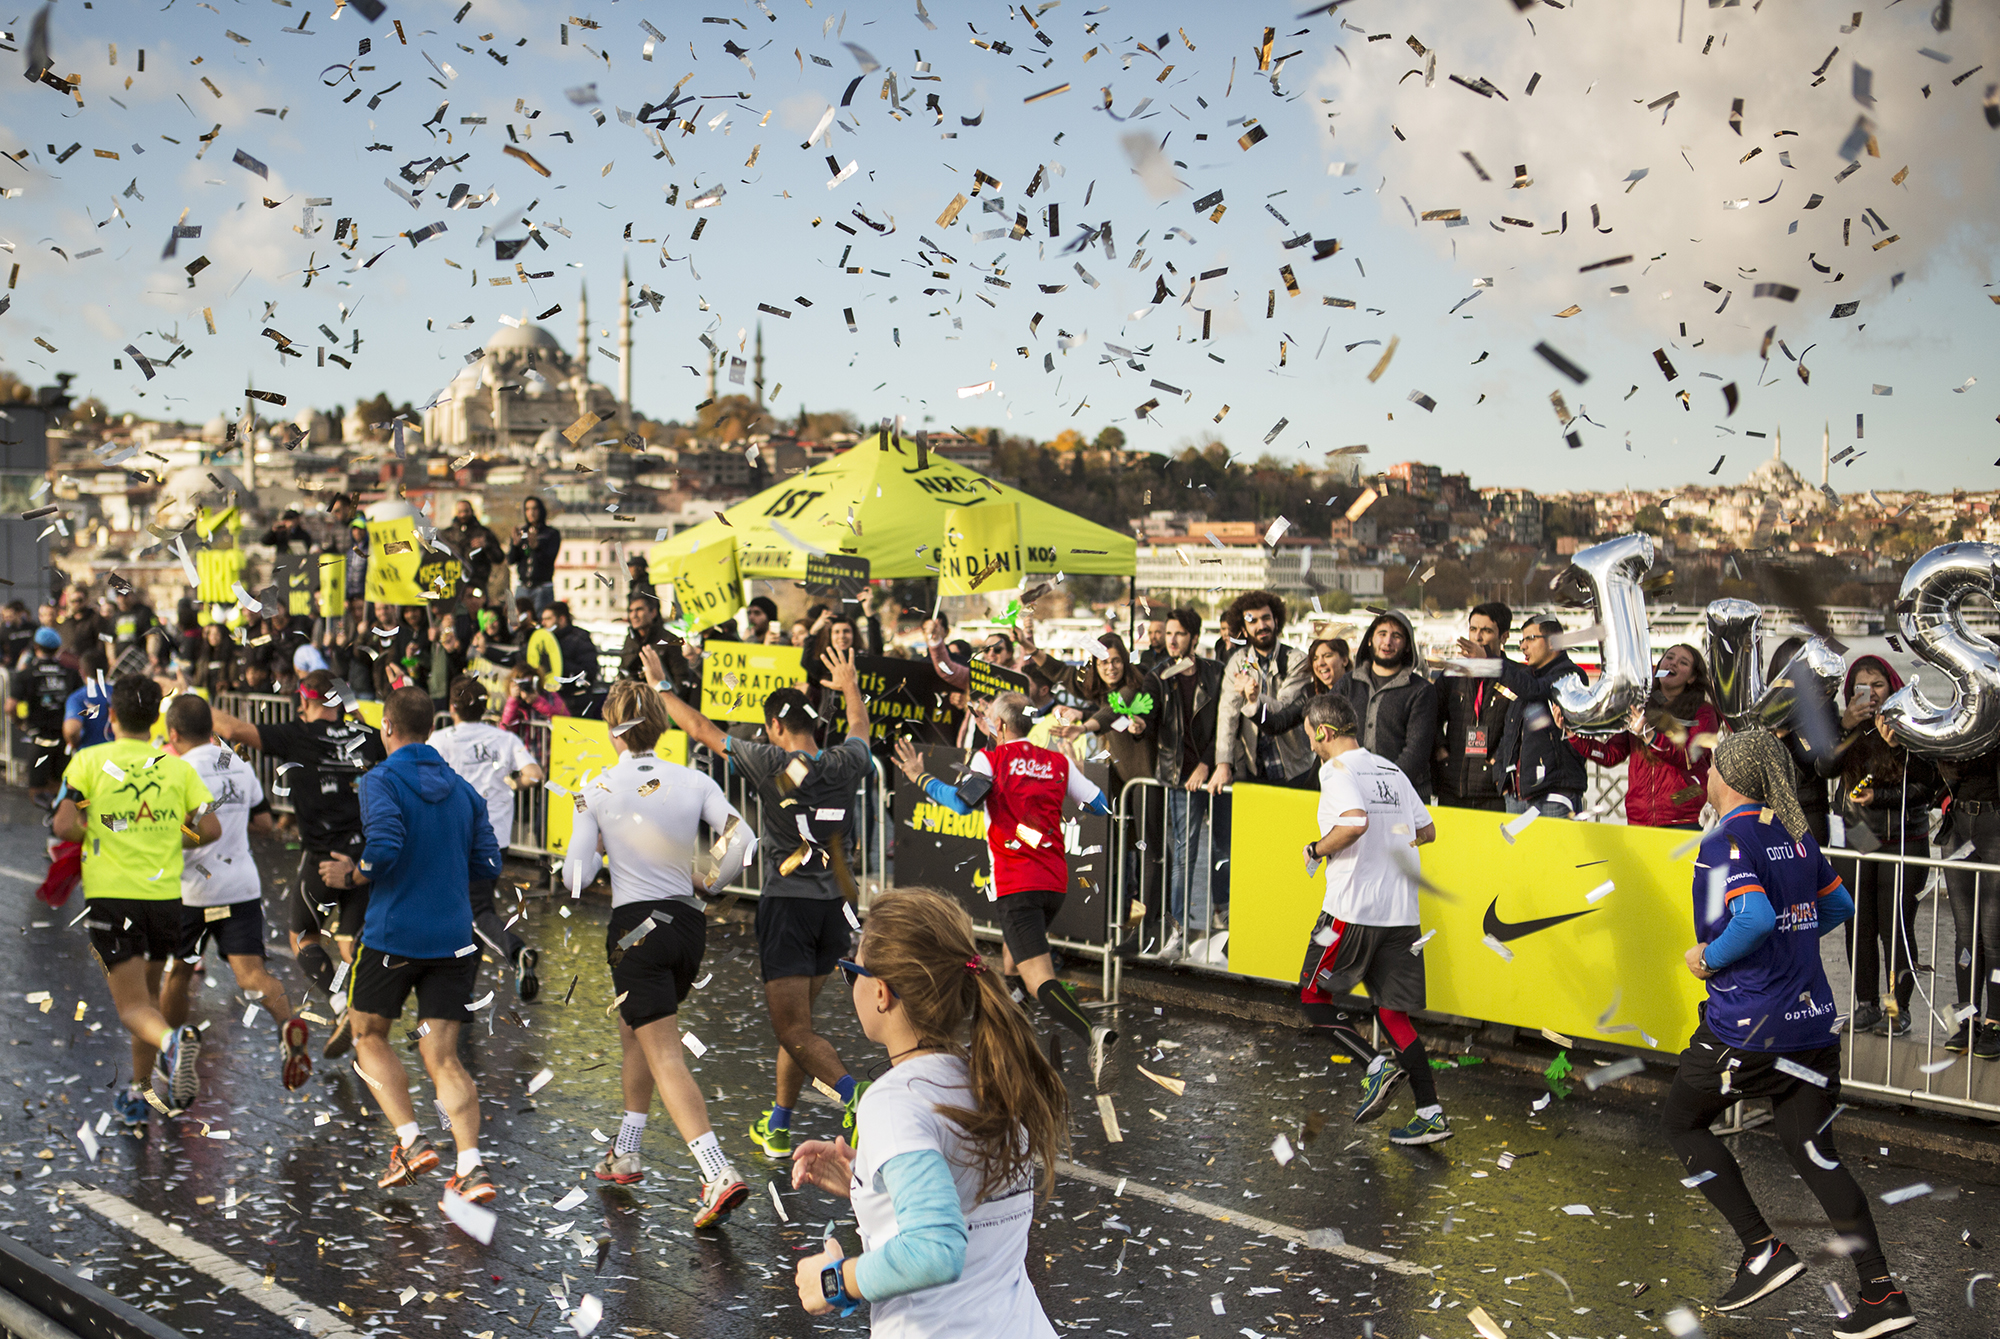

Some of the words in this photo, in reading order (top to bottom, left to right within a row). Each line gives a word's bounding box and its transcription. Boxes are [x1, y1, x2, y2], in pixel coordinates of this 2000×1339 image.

[914, 476, 976, 495] NRC
[763, 488, 826, 519] IST
[942, 544, 1022, 578] NDİNİ
[429, 579, 456, 599] ST
[712, 652, 747, 668] SON
[711, 671, 799, 690] MRATON
[1009, 757, 1027, 776] 13
[1766, 841, 1795, 861] ODTÜ
